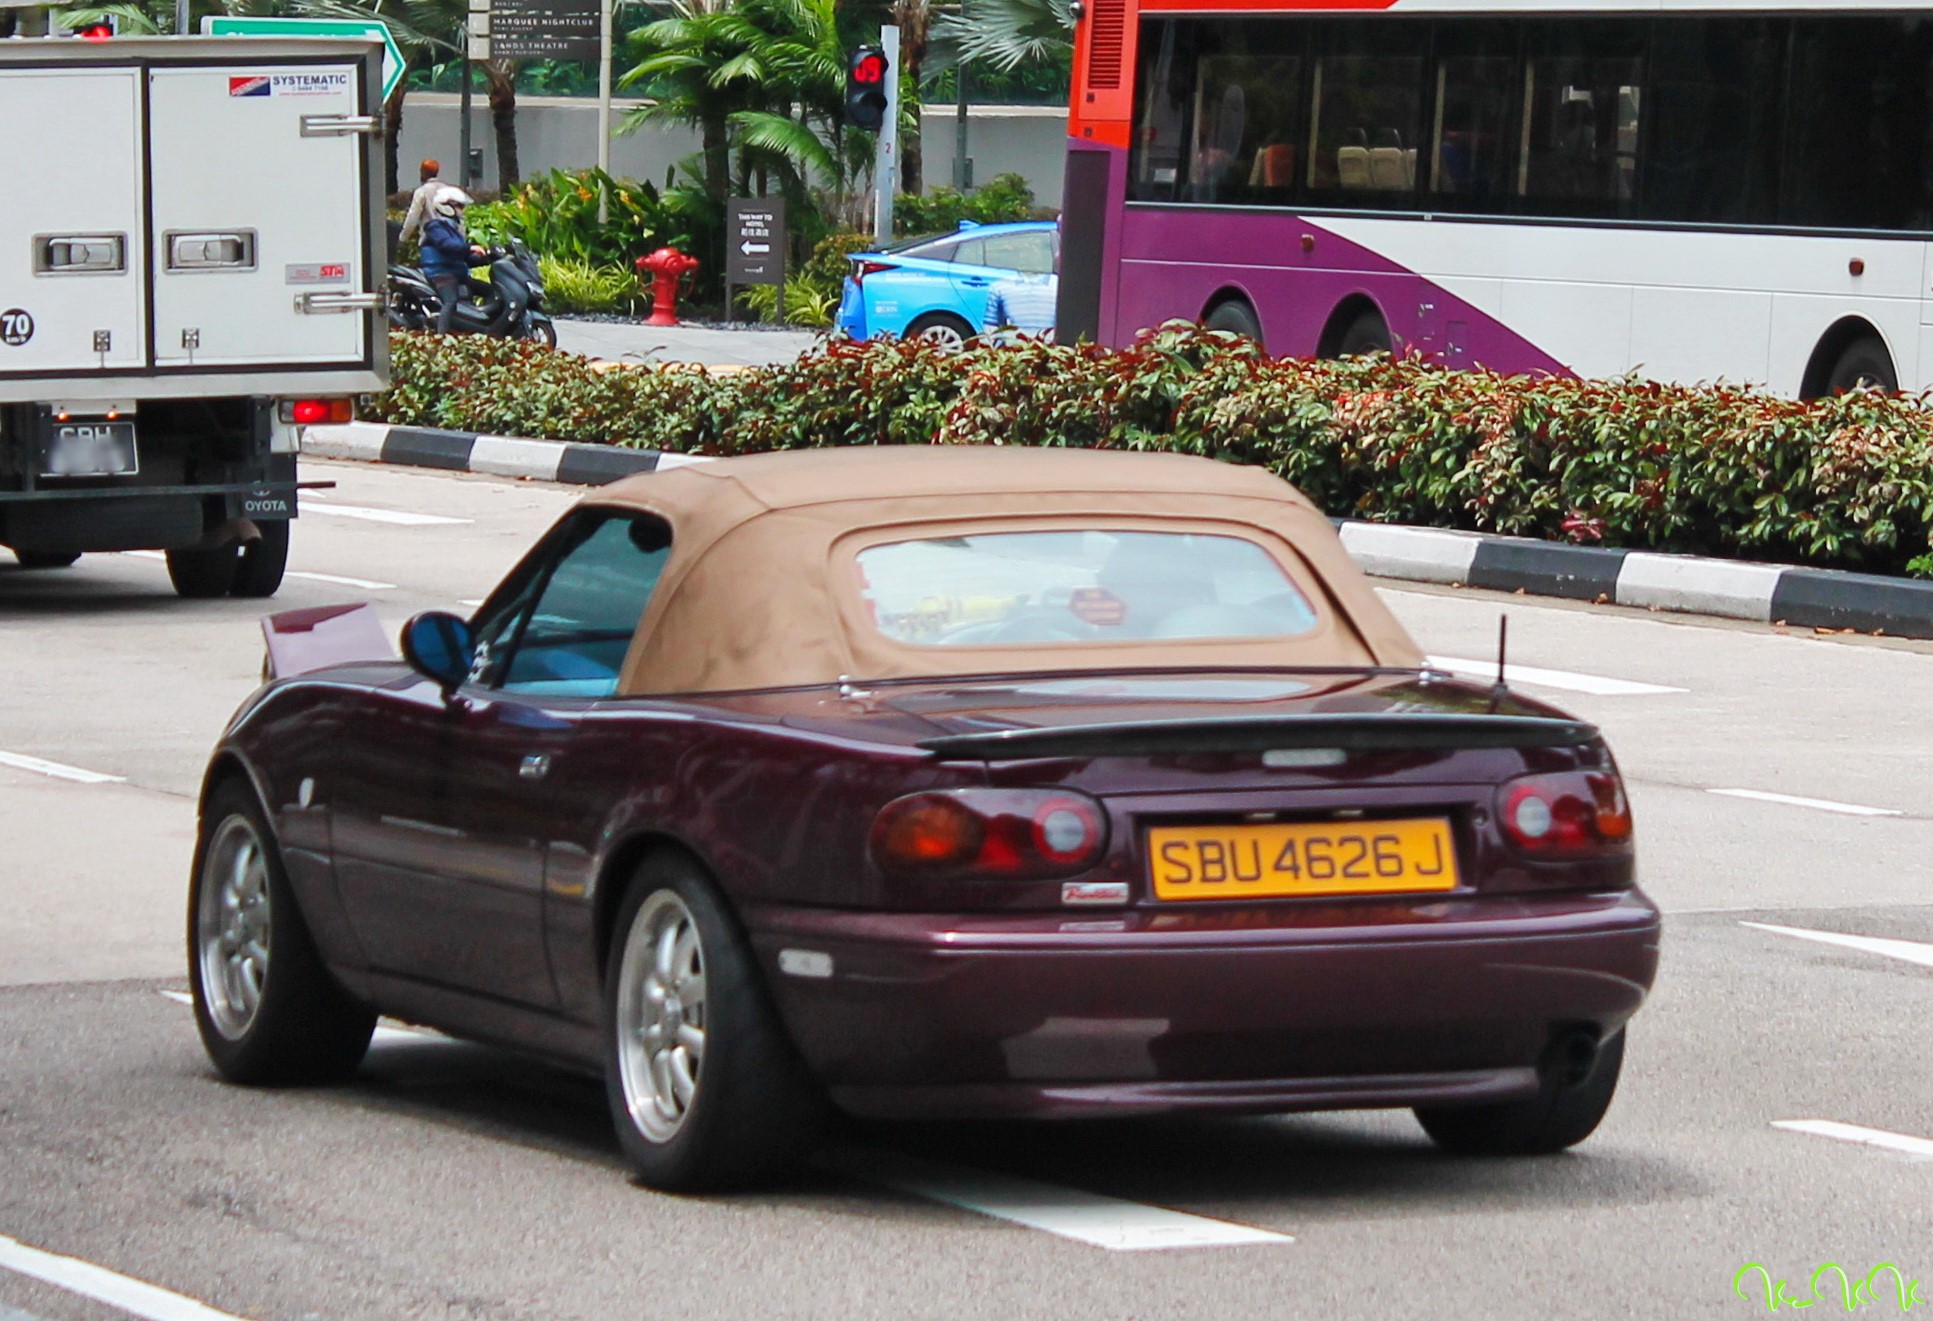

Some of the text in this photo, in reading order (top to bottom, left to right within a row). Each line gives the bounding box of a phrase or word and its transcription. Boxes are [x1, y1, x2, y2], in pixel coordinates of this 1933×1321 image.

[273, 74, 347, 85] SYSTEMATIC
[2, 314, 30, 335] 70
[245, 500, 287, 511] OYOTA
[1161, 831, 1444, 884] SBU 4626 J
